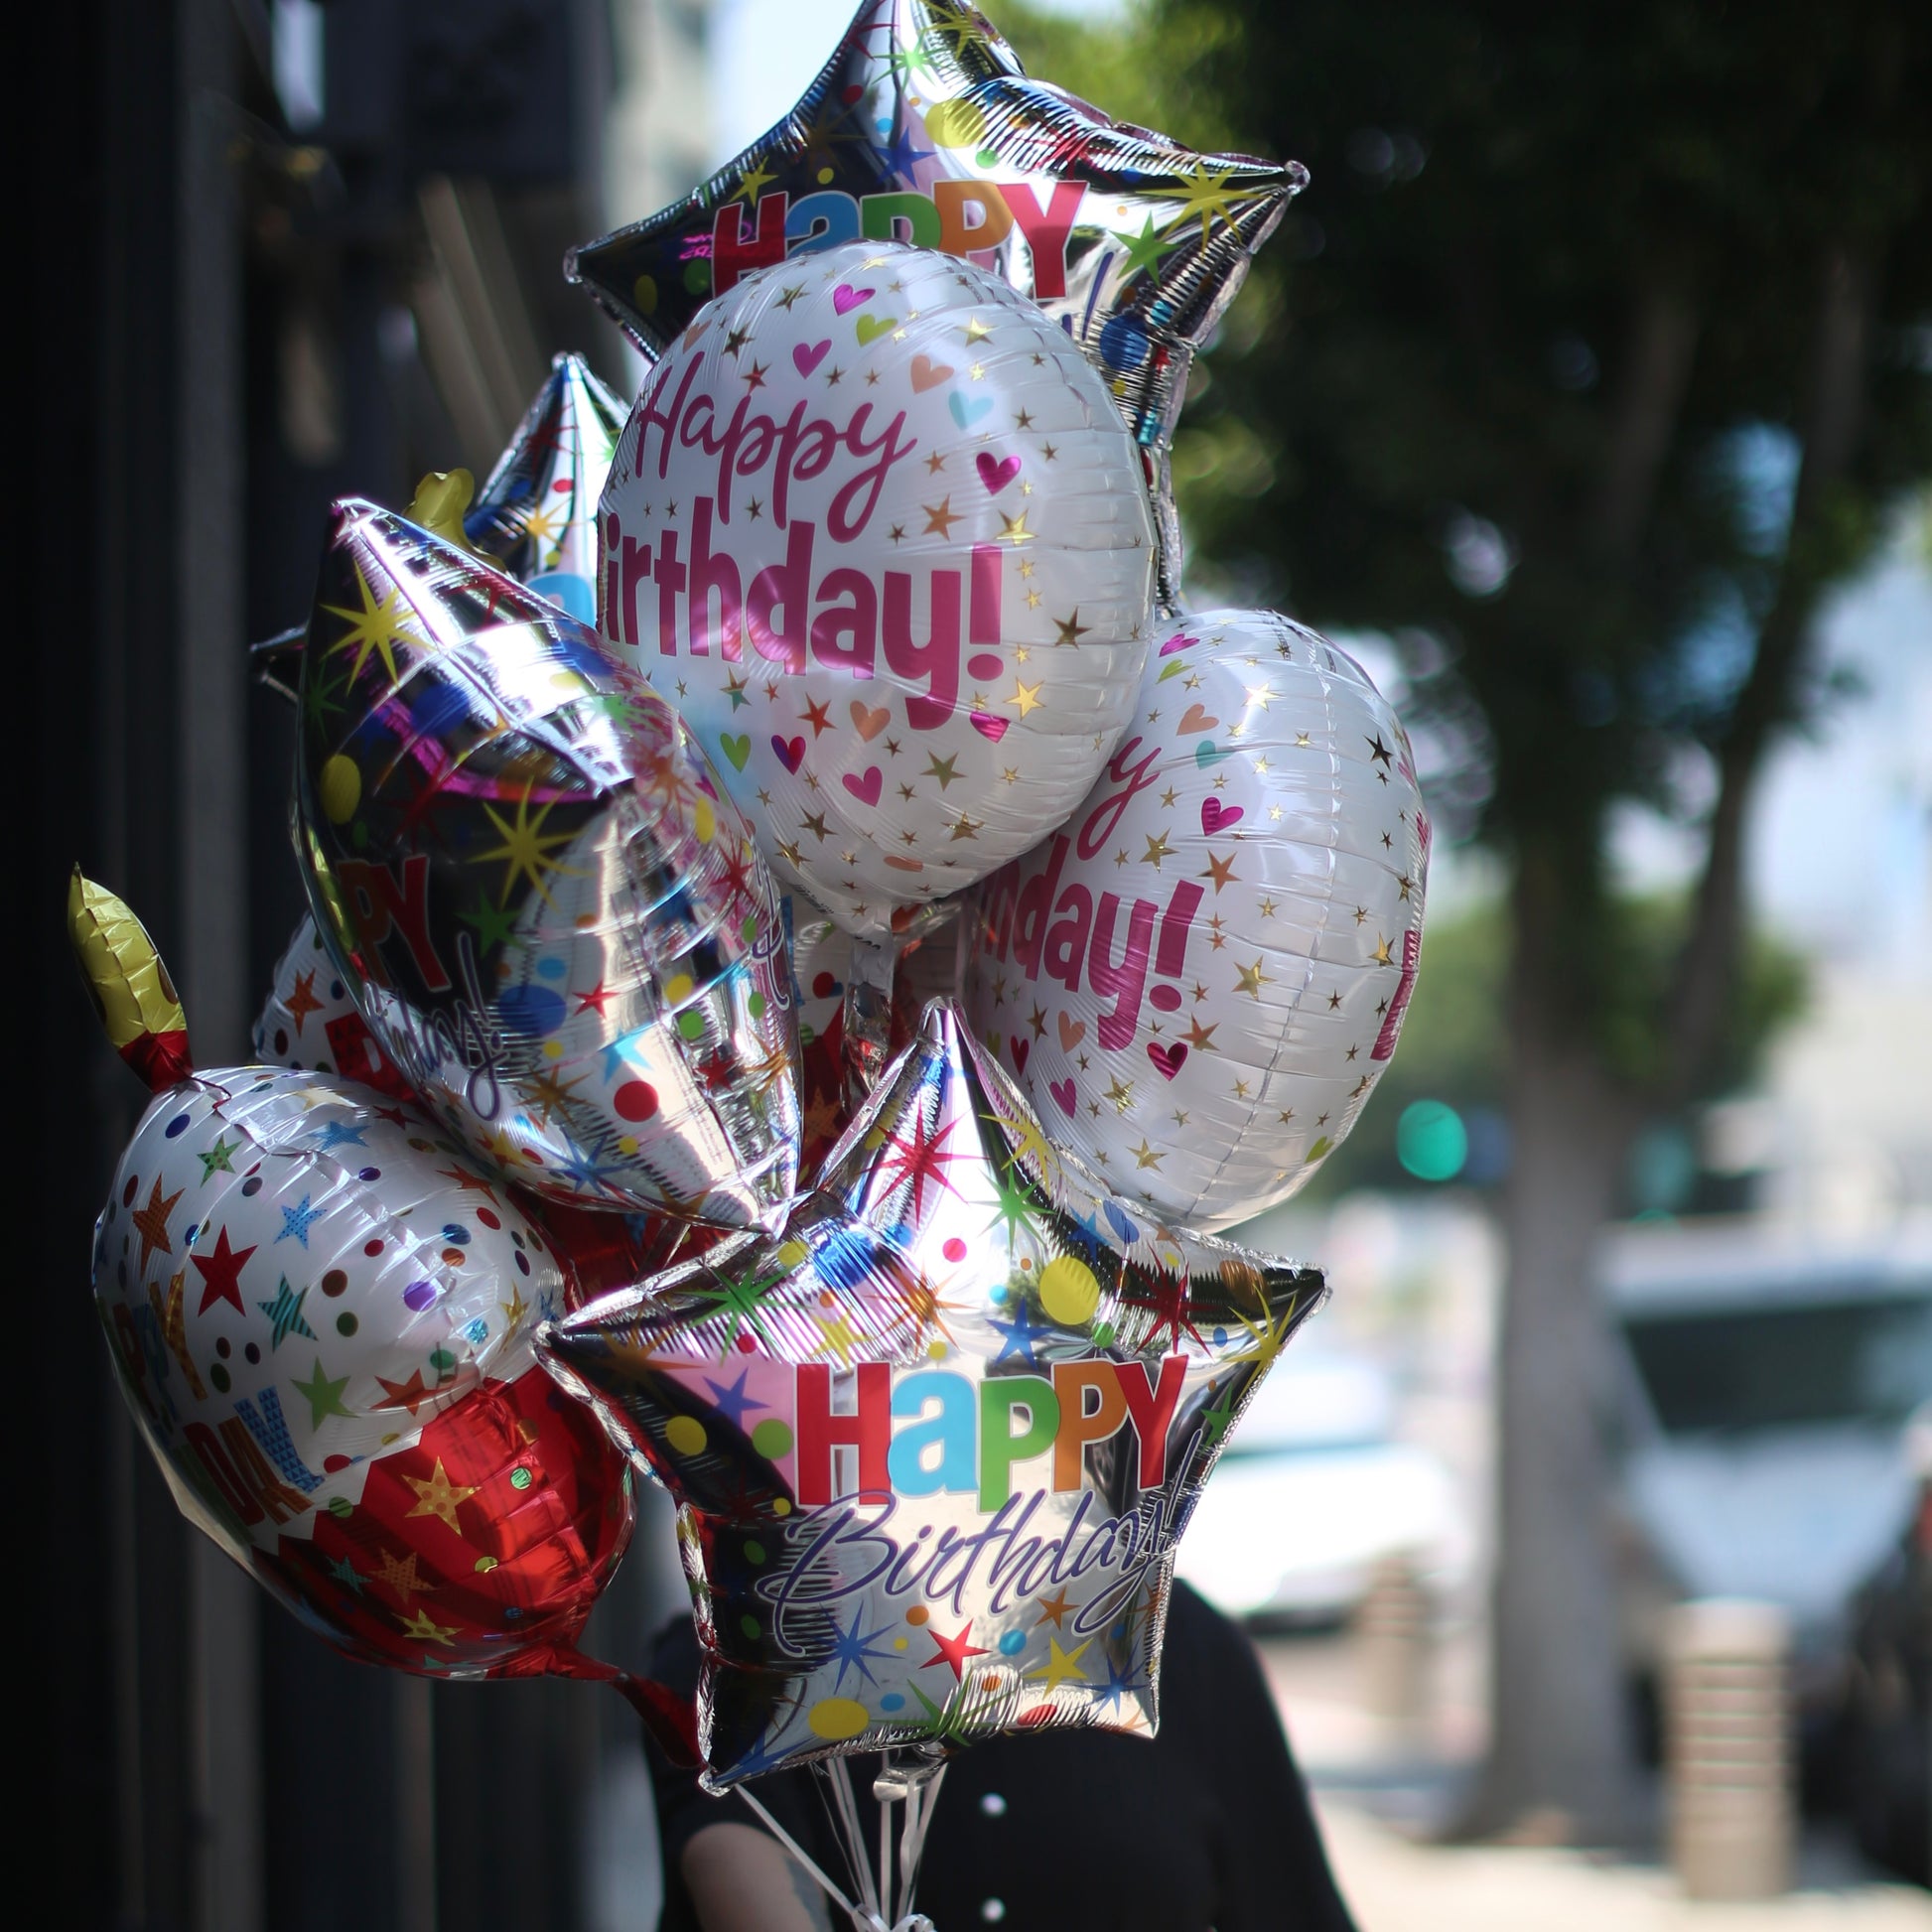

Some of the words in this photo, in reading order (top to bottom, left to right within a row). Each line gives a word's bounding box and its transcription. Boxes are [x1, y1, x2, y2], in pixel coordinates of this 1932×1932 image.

[634, 350, 918, 543] Happy
[598, 495, 1005, 732] irthday!
[756, 1428, 1203, 1658] Birthday!
